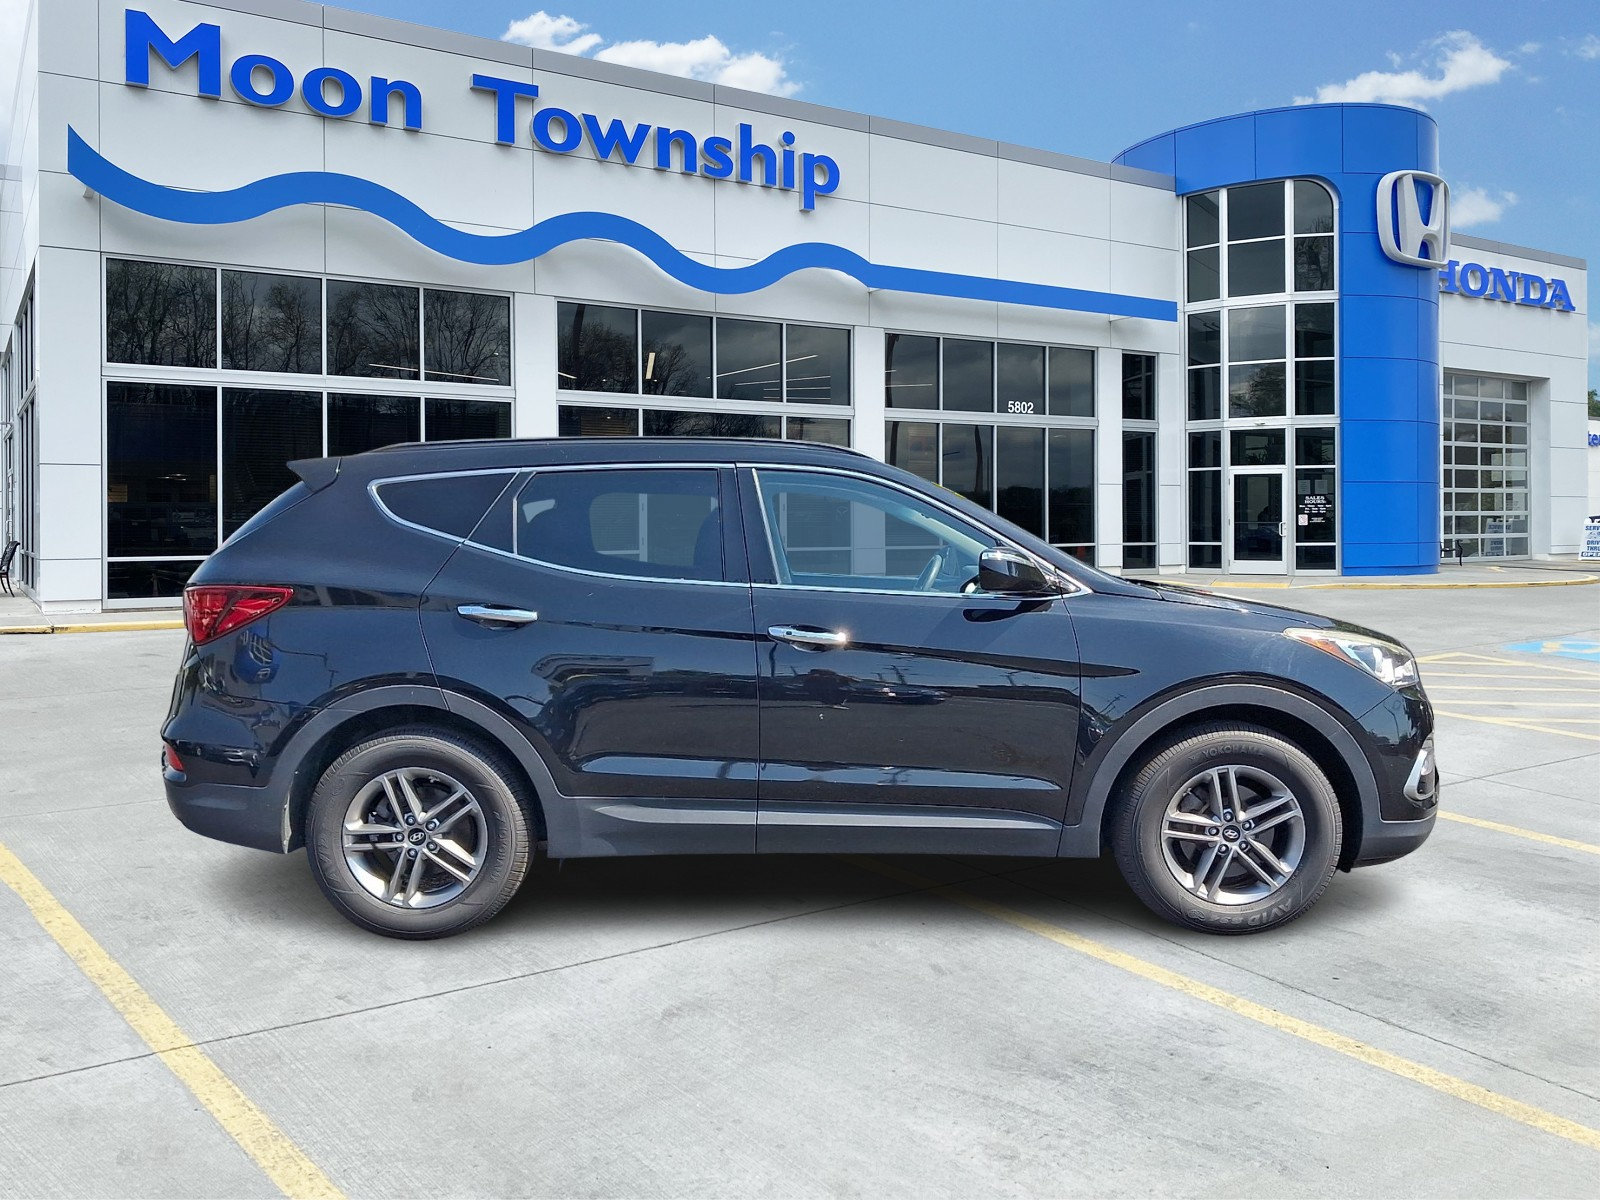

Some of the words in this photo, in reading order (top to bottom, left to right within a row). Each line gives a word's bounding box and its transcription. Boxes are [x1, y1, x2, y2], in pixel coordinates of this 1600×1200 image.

[125, 9, 422, 132] Moon
[471, 74, 841, 213] Township
[1007, 400, 1034, 414] 5802
